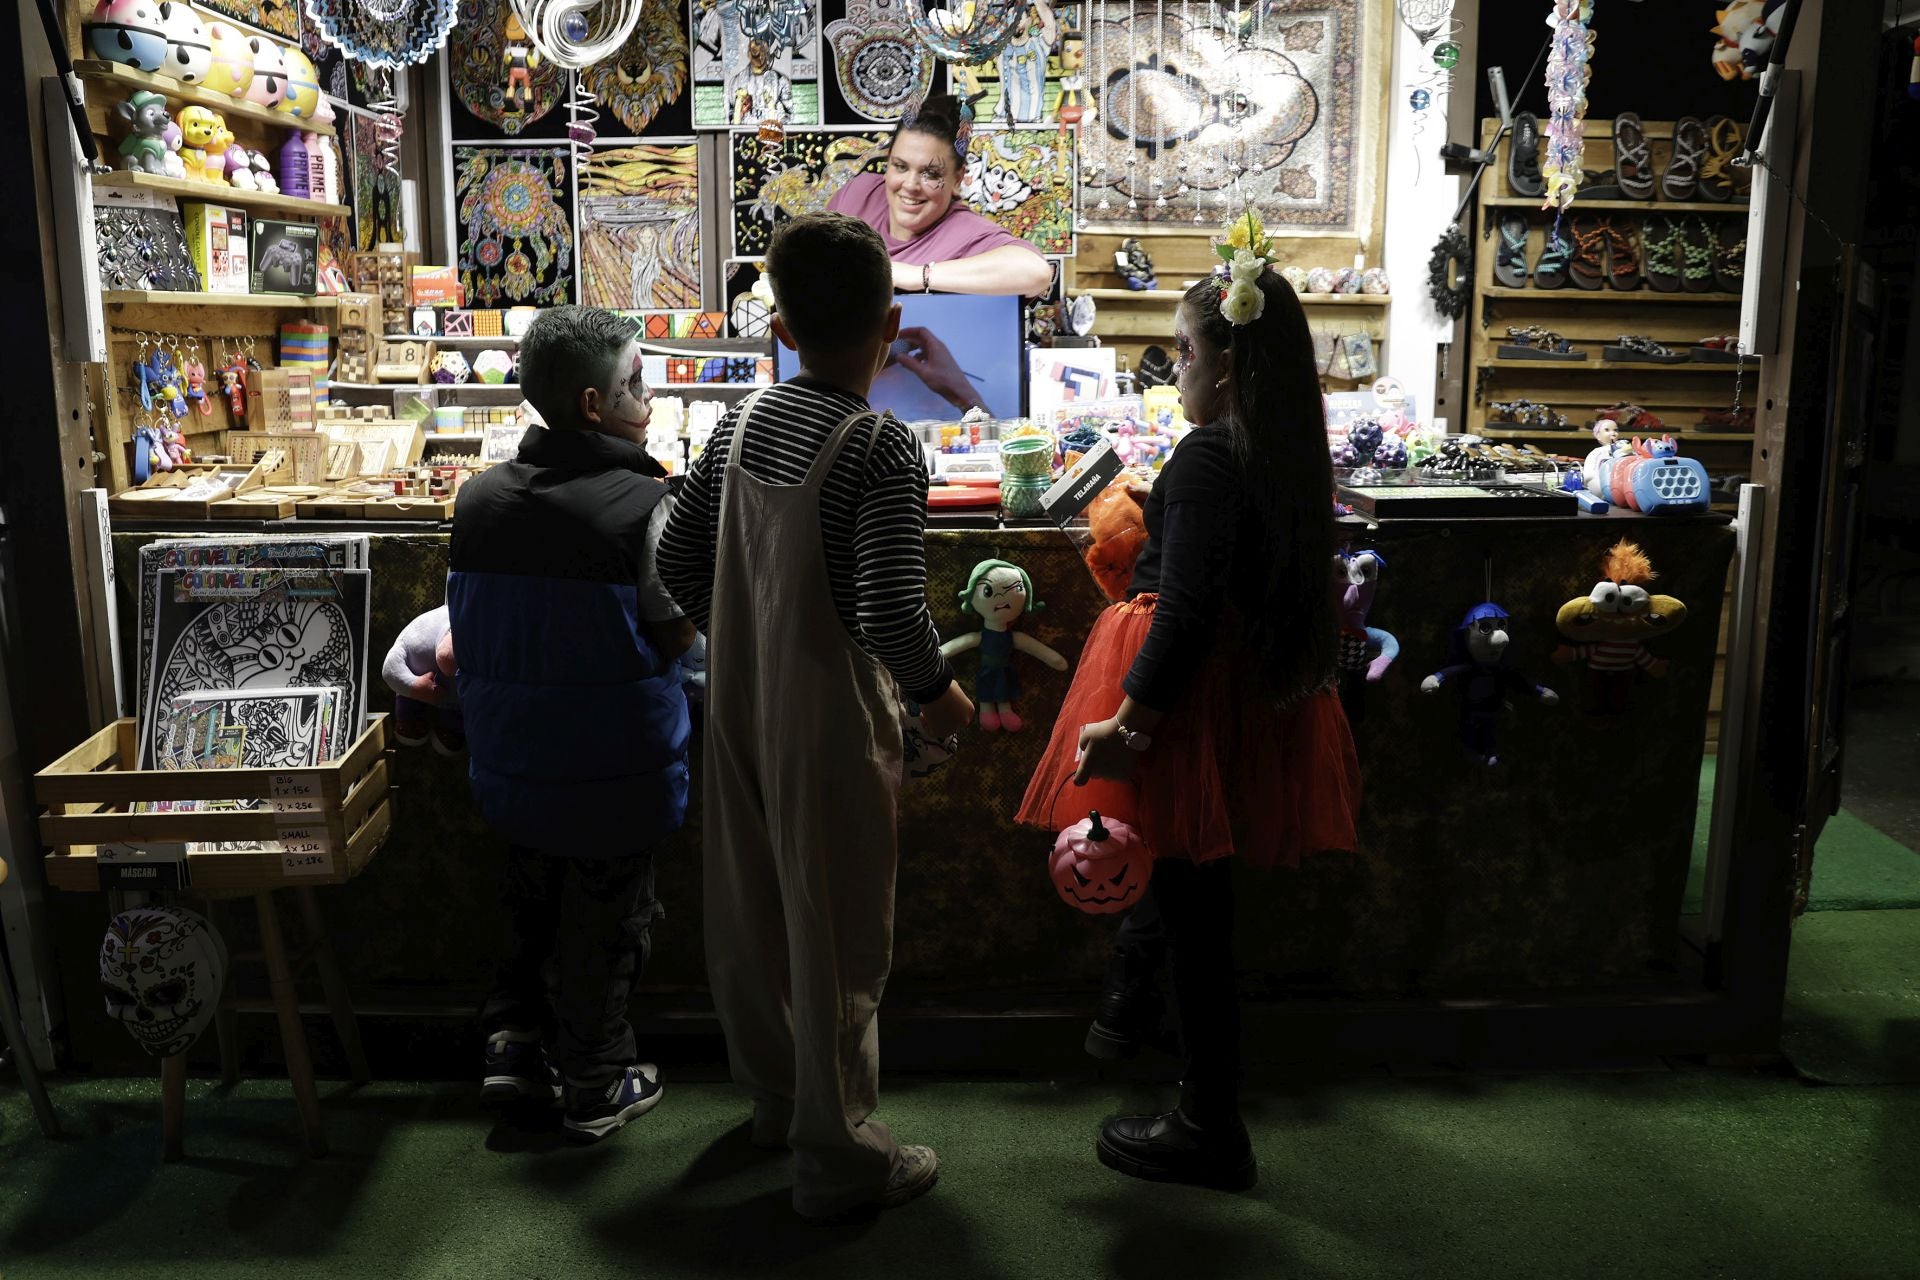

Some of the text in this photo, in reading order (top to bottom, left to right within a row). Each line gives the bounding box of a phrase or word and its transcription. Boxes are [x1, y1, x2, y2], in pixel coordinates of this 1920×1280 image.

[293, 151, 308, 190] PRIME
[311, 155, 325, 192] PRIME
[1073, 473, 1102, 501] TELARAÑA
[164, 547, 255, 568] COLORVELVET
[182, 571, 270, 590] COLORVELVET
[277, 803, 285, 812] 2
[295, 802, 313, 810] 25€
[282, 830, 310, 840] SMALL
[284, 844, 290, 852] 1
[302, 844, 320, 852] 10€
[286, 858, 295, 868] 2
[120, 865, 157, 878] MÁSCARA
